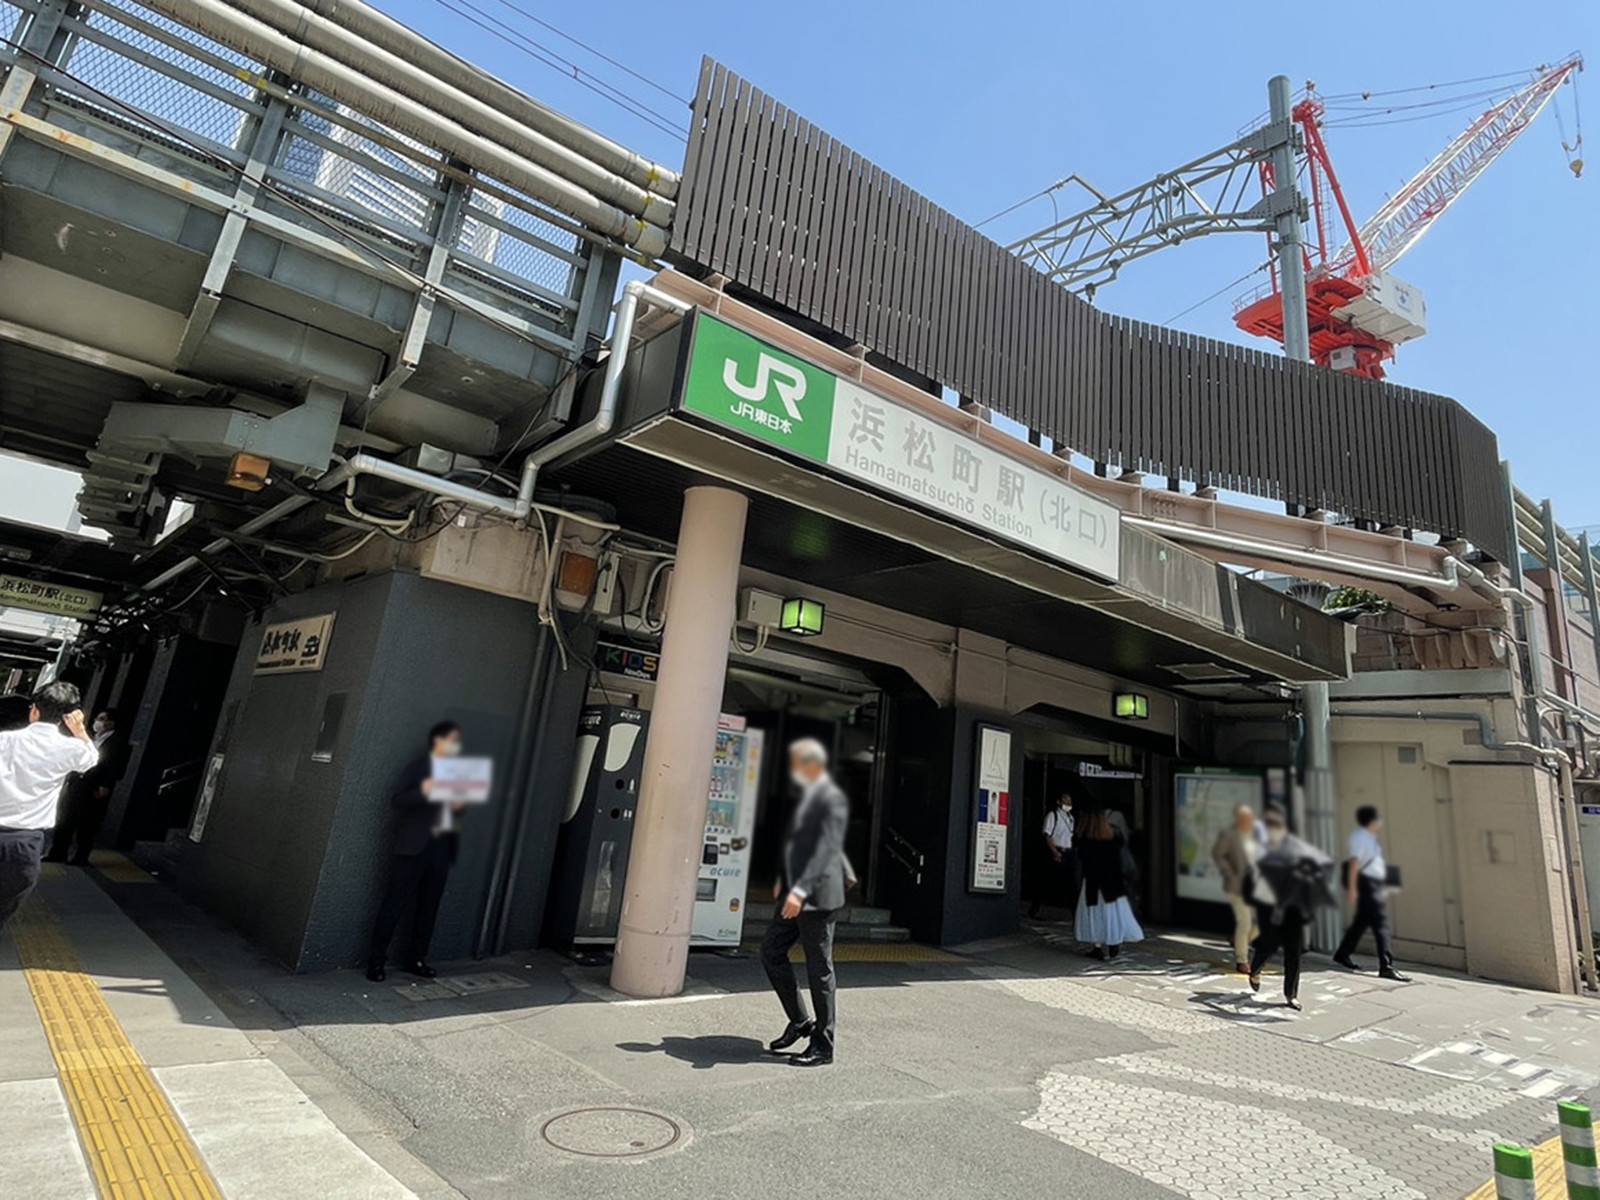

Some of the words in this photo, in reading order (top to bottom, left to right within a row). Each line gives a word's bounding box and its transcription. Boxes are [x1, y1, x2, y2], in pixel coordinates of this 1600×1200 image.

[723, 352, 807, 422] JR
[730, 401, 793, 435] JR東日本
[845, 446, 975, 514] Hamamatsuchō
[982, 502, 1033, 539] Station
